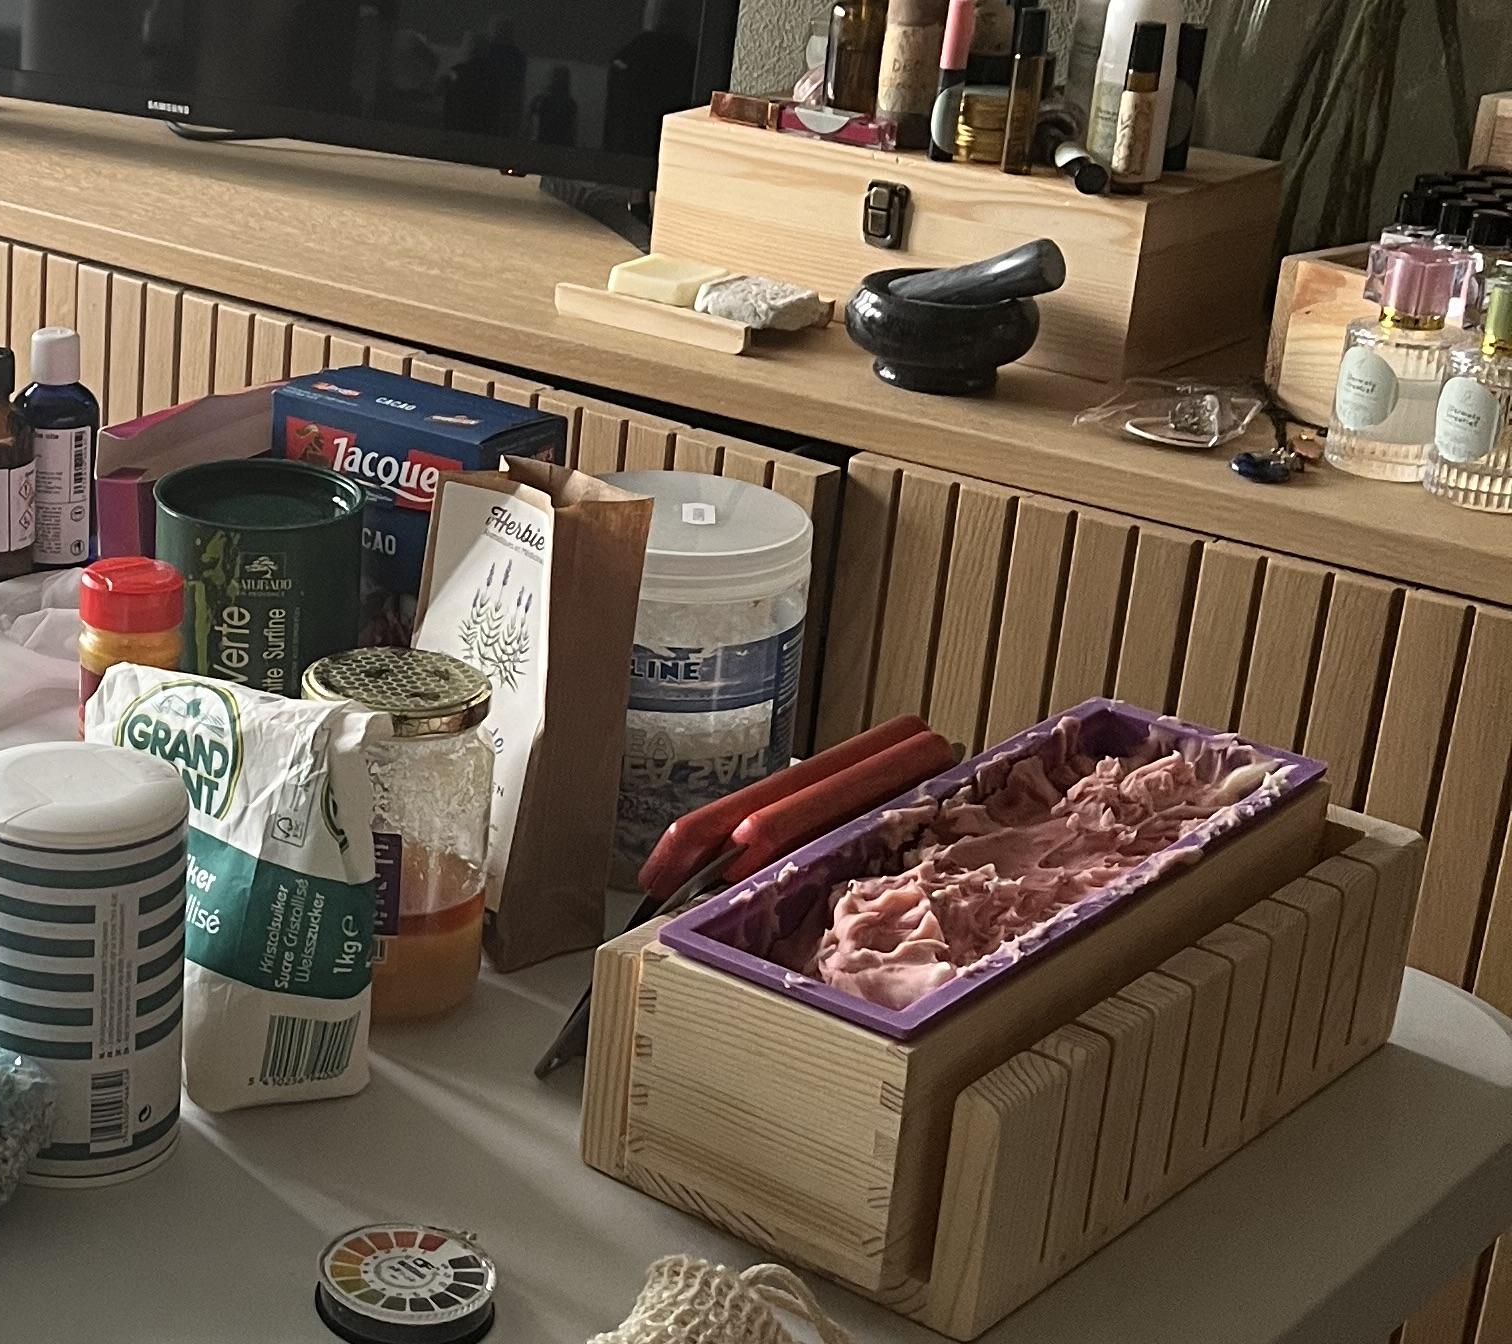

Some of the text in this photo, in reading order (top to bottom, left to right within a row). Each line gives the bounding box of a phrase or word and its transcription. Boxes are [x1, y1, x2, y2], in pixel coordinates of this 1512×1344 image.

[147, 100, 190, 115] SAMSUNG
[375, 396, 417, 412] CACAO
[332, 436, 440, 495] Jacque
[361, 527, 397, 556] CAO
[235, 578, 293, 591] ATURADO
[212, 606, 251, 684] Verte
[262, 608, 286, 660] Surfine
[630, 657, 701, 682] LINE
[127, 713, 230, 779] GRAND
[181, 768, 220, 816] NT
[186, 852, 217, 893] ker
[259, 884, 289, 974] Kristalsuiker
[274, 878, 309, 989] Sucre Cristallisé
[294, 892, 325, 983] Weisszucker
